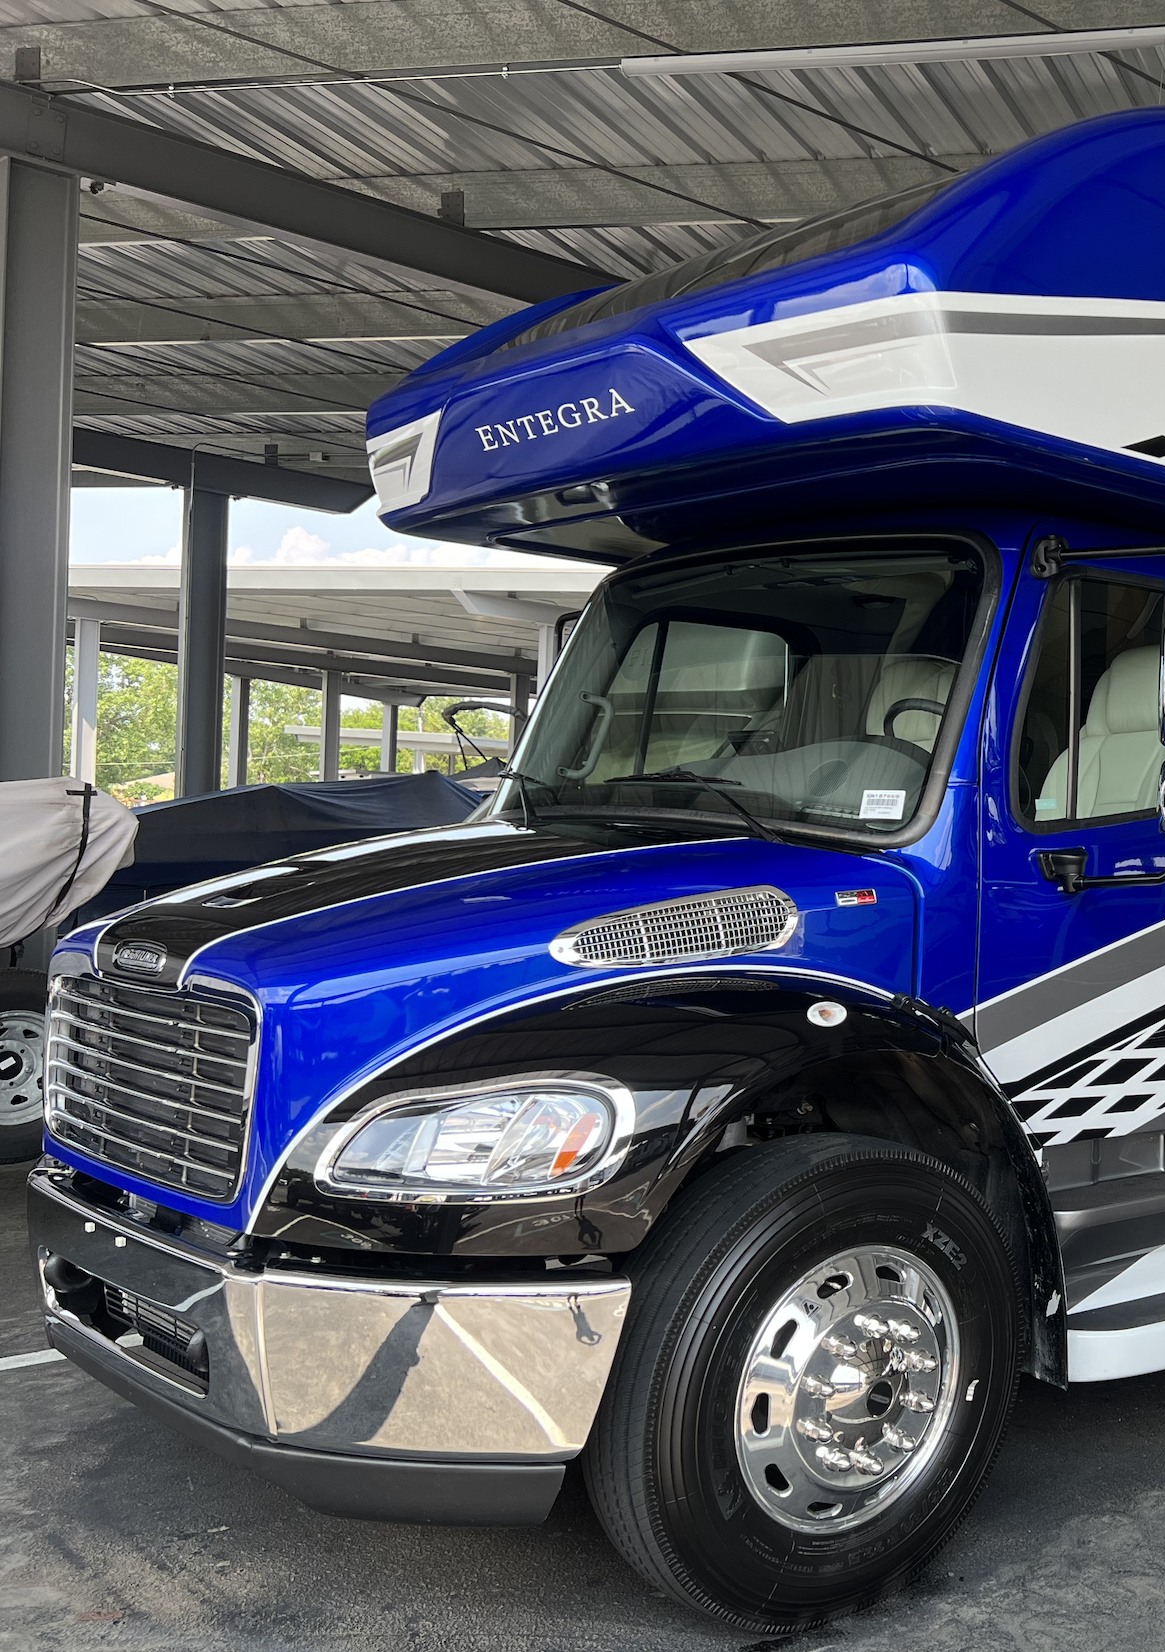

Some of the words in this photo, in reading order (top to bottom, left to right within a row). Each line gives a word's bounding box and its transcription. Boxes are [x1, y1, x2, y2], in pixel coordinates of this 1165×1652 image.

[475, 388, 635, 452] ENTEGRA
[921, 1220, 967, 1271] XZE2
[711, 1289, 767, 1470] MICHELIN
